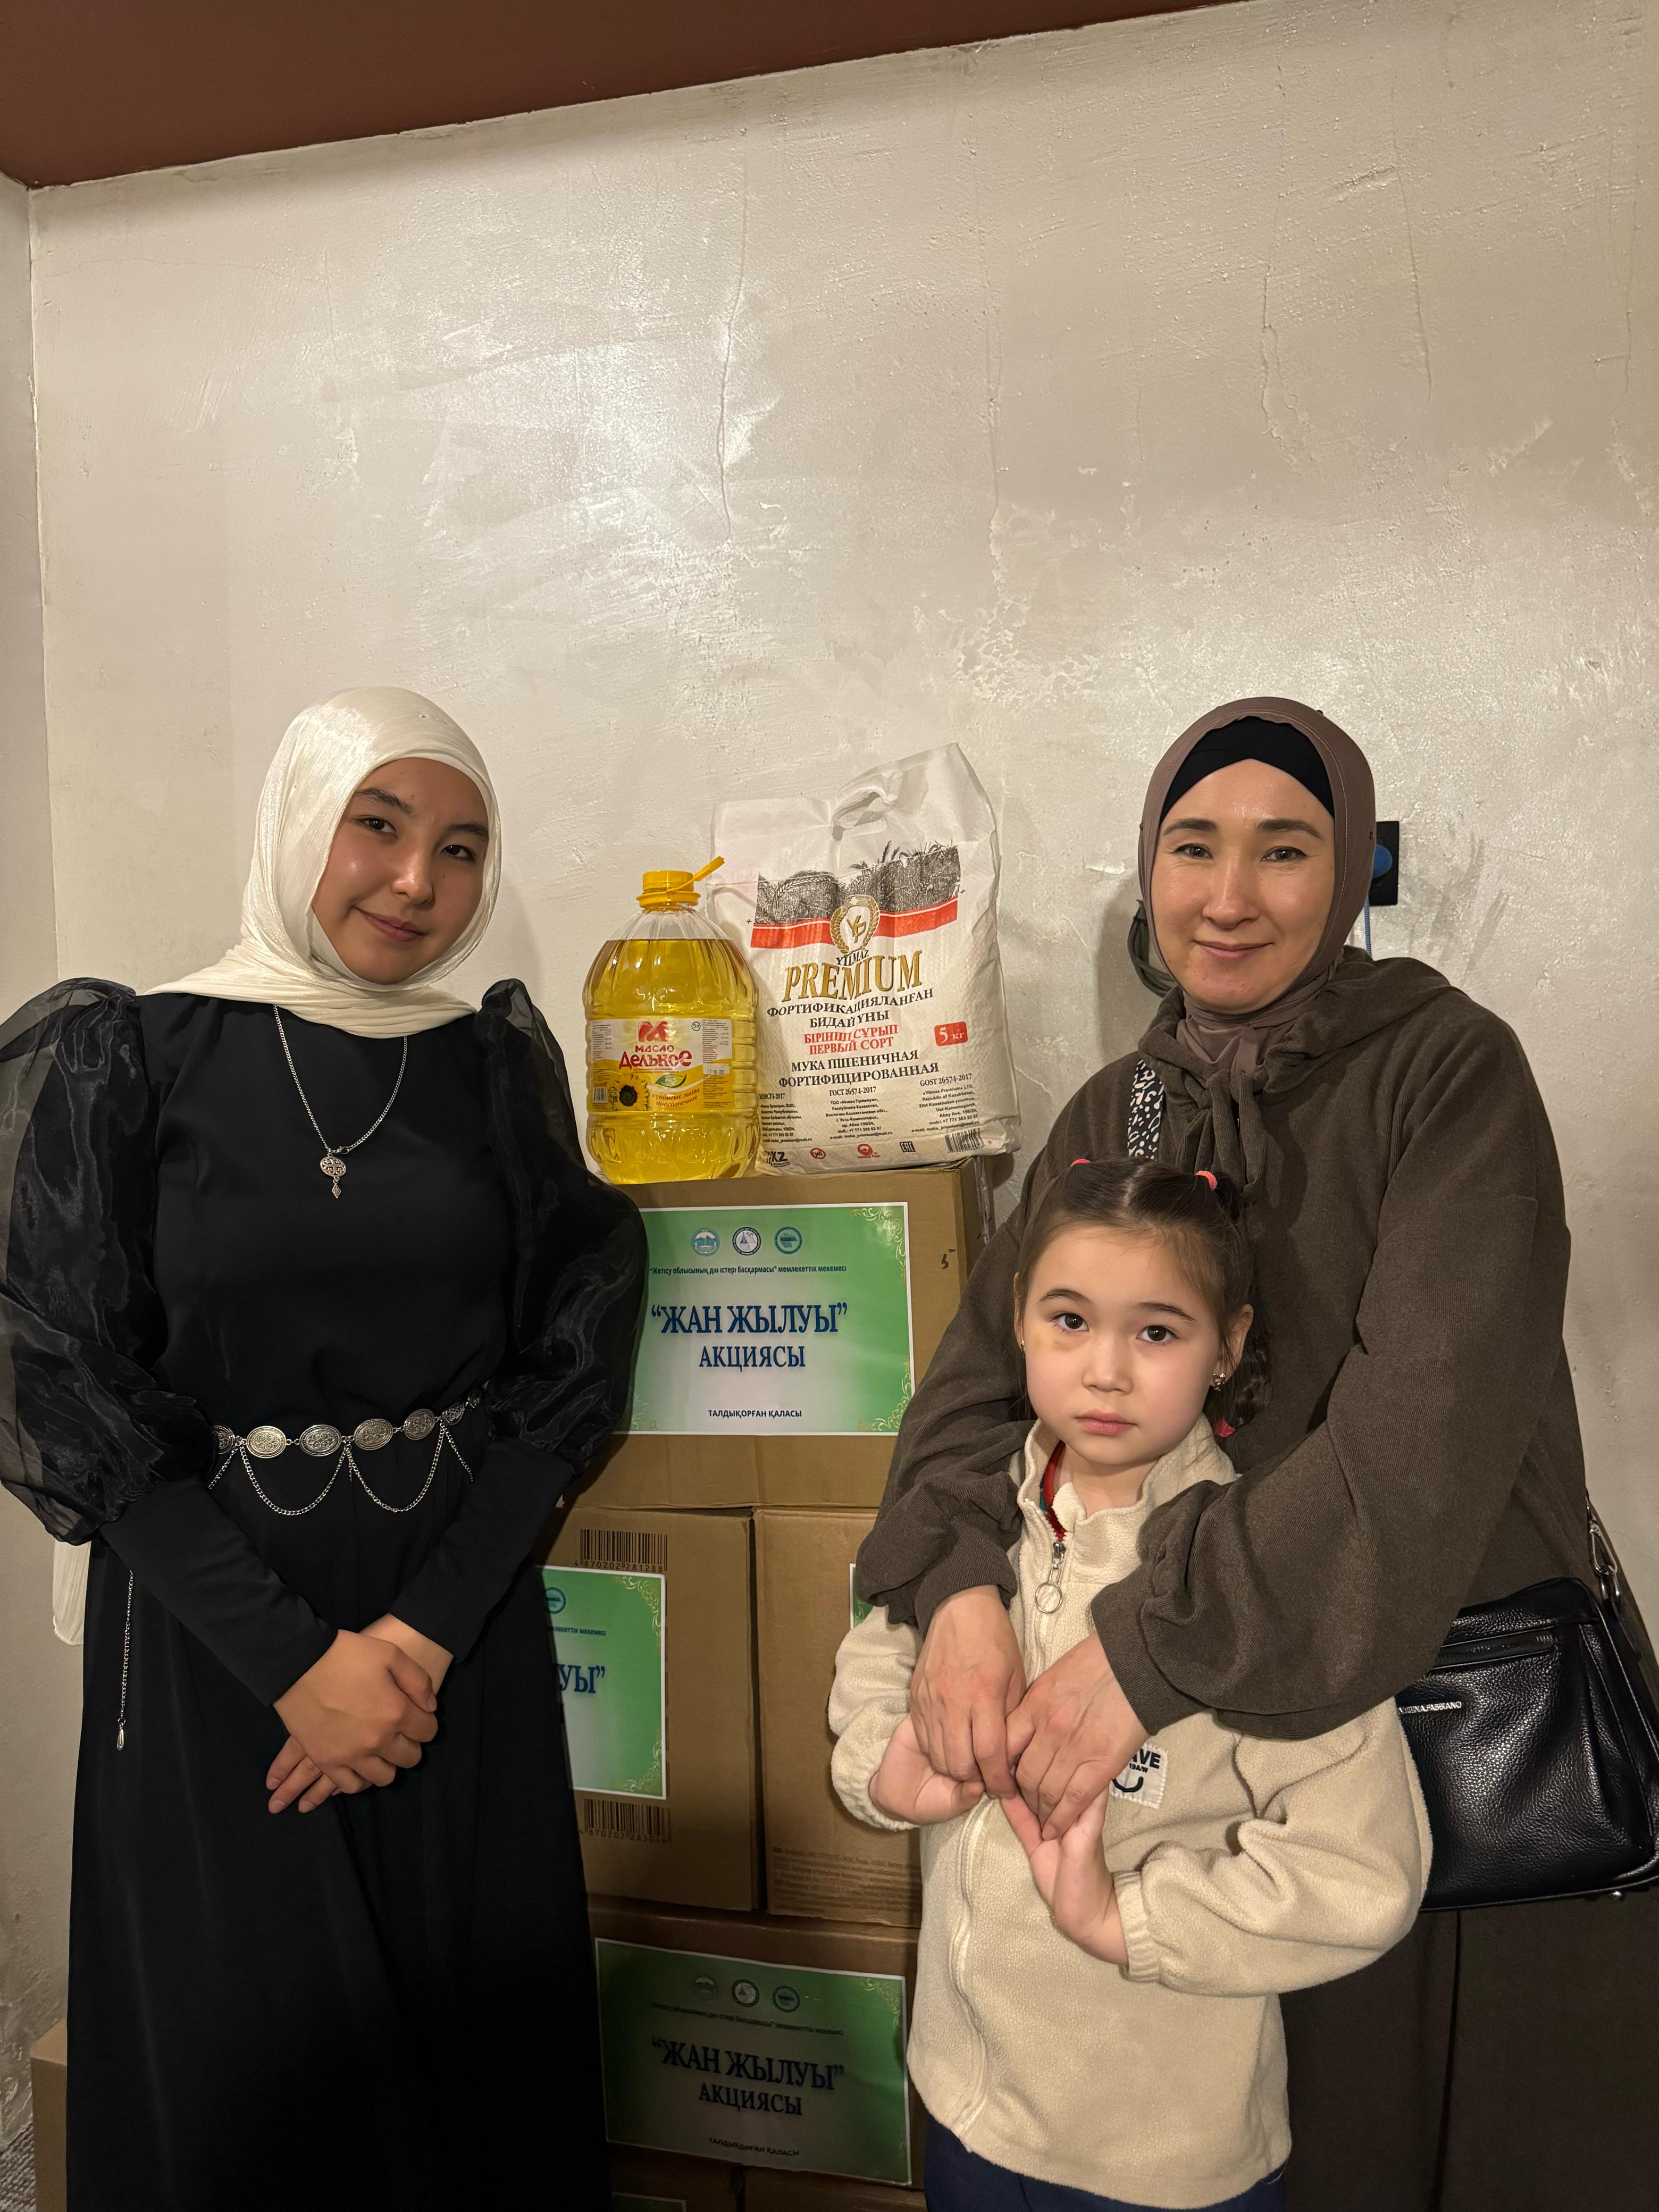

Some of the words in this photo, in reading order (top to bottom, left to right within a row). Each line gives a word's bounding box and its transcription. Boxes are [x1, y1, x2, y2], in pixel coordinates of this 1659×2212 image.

[836, 949, 869, 966] YILMAZ
[782, 950, 923, 1002] PREMIUM
[767, 987, 933, 1017] ФОРТИФИКАЦИЯЛАНҒАН
[809, 1016, 855, 1028] БИДАЙ
[804, 1032, 851, 1043] БІРІНШІ
[940, 1027, 948, 1043] 5
[809, 1040, 857, 1055] ПЕРВЫЙ
[860, 1037, 893, 1050] СОРТ
[791, 1061, 824, 1072] МУКА
[828, 1050, 918, 1069] ПШЕНИЧНАЯ
[779, 1062, 939, 1087] ФОРТИФИЦИРОВАННАЯ
[939, 1073, 972, 1084] 26574-2017
[845, 1086, 876, 1095] 26574-2017
[656, 1095, 698, 1107] подсолнечное
[699, 1346, 806, 1372] АКЦИЯСЫ
[708, 1410, 766, 1418] ТАЛДЫҚОРҒАН
[699, 2083, 802, 2115] АКЦИЯСЫ
